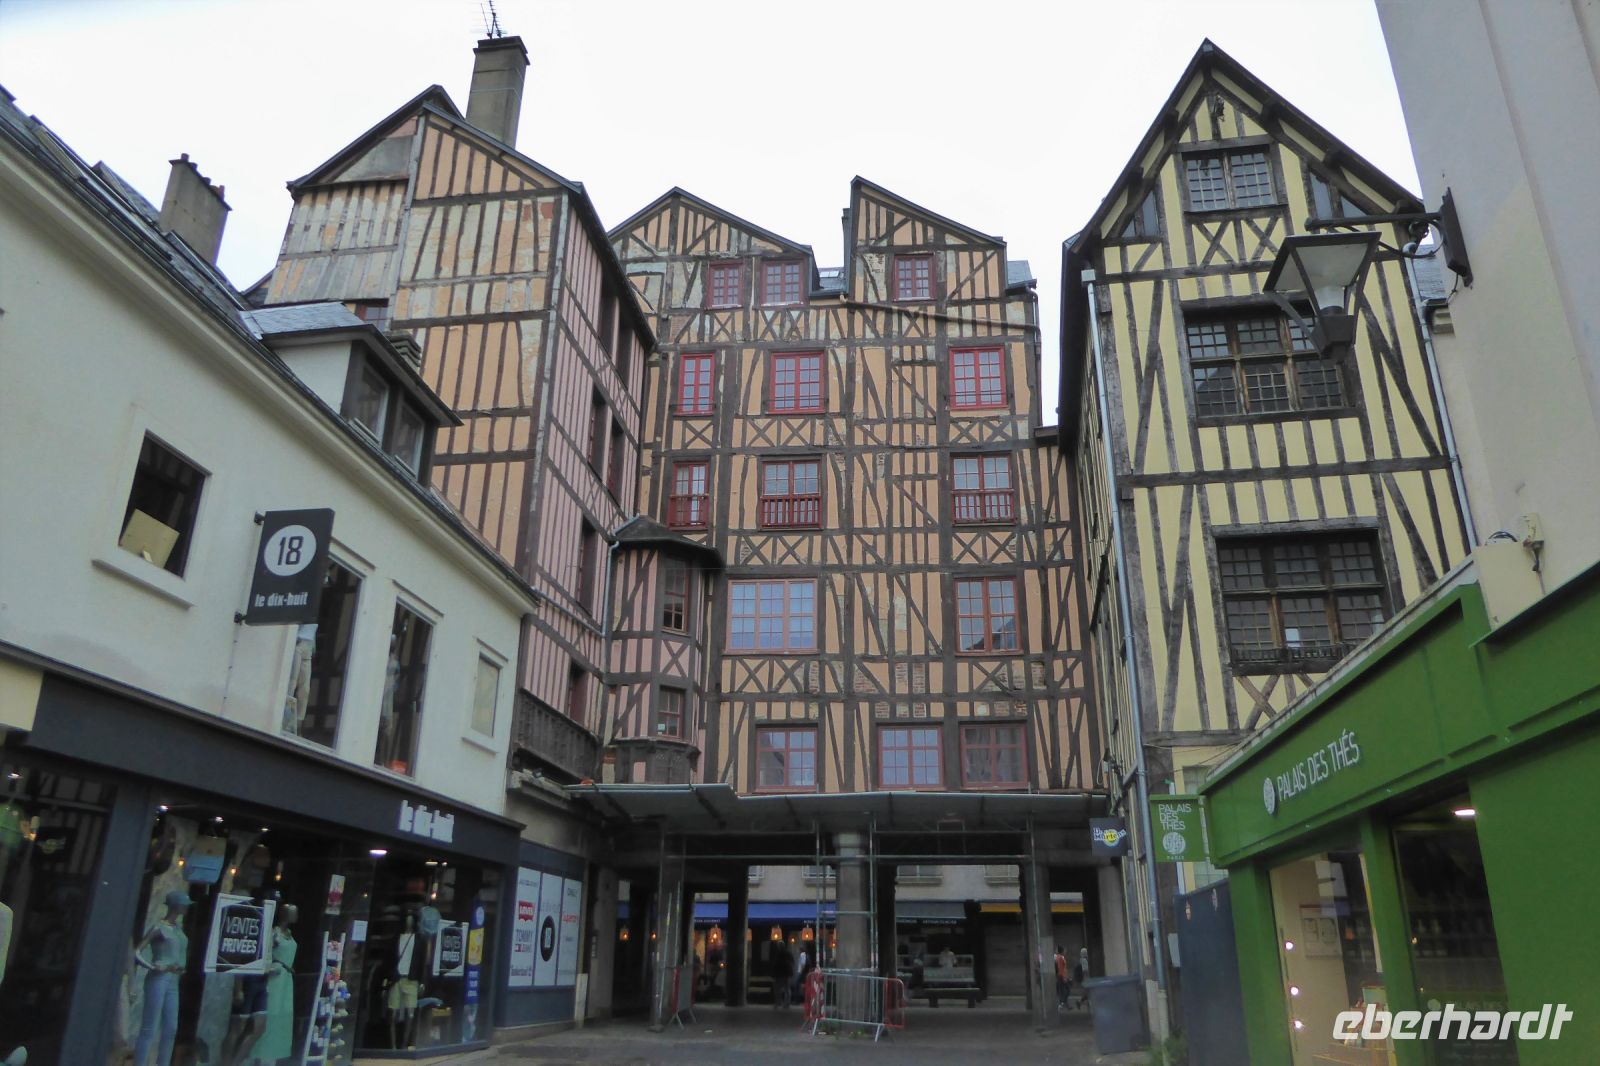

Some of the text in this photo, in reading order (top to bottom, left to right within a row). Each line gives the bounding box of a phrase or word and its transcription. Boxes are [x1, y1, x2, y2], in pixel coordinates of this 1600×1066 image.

[278, 536, 304, 565] 18
[255, 592, 308, 607] le dix-huit
[1276, 728, 1360, 802] PALAIS DES THÉS
[1158, 803, 1192, 814] PALAIS
[1160, 813, 1179, 822] DES
[226, 916, 260, 936] VENTES
[221, 935, 258, 953] PRIVÉES
